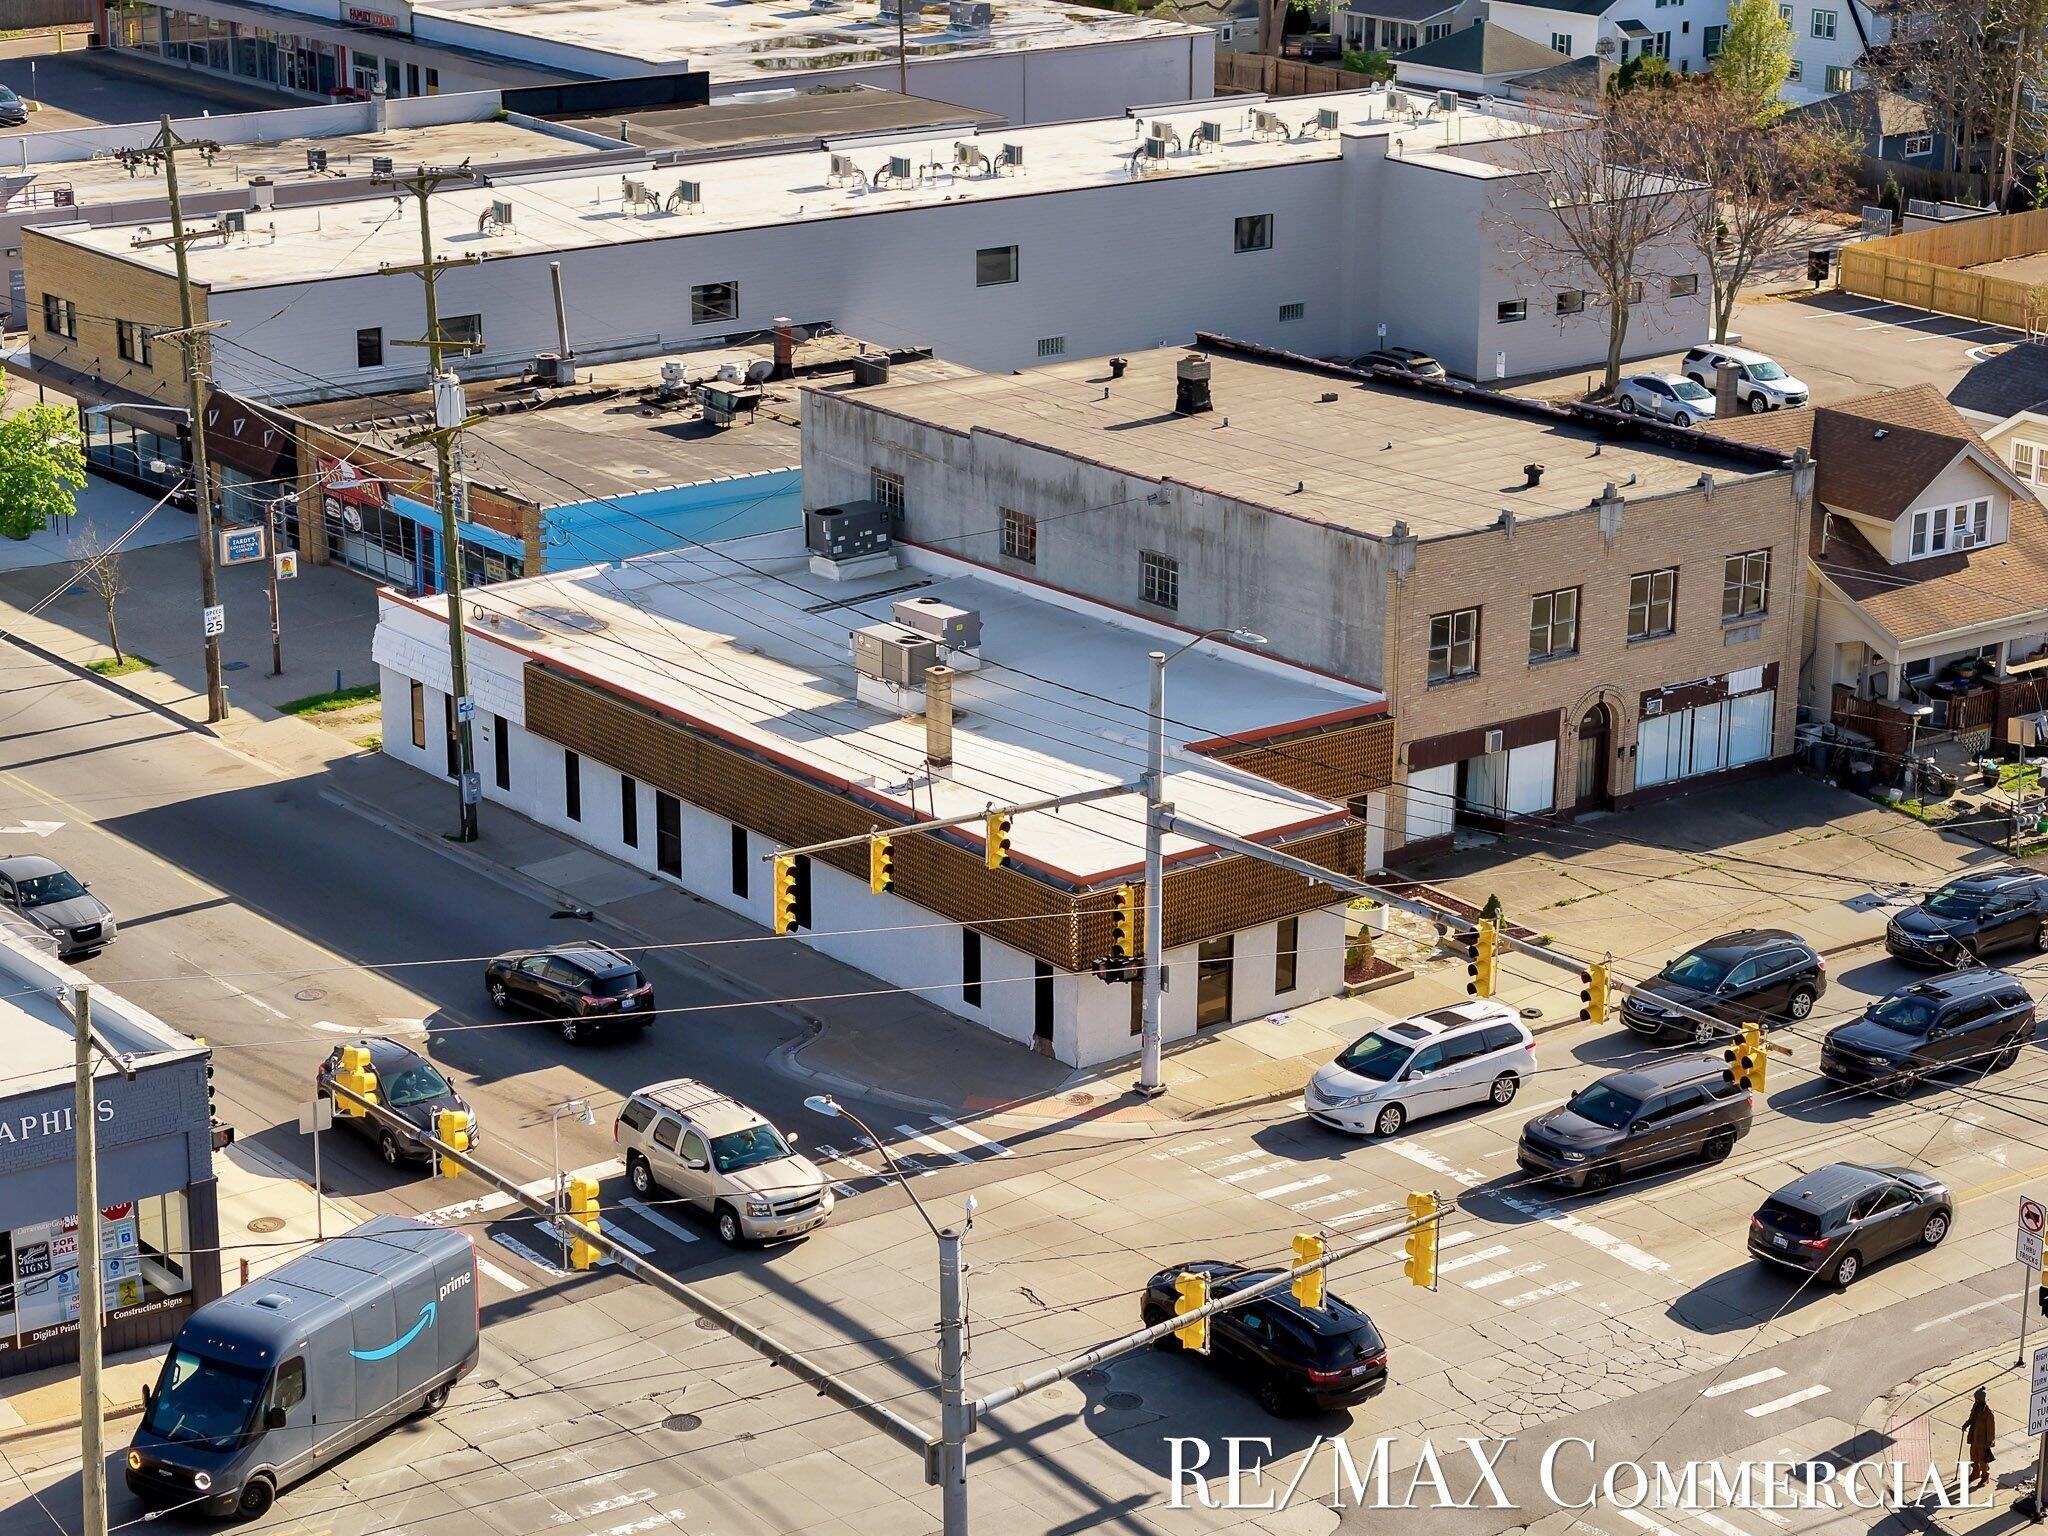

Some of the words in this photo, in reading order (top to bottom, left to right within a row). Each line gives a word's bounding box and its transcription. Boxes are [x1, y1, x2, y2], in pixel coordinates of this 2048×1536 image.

[232, 536, 256, 545] TARDY'S
[206, 608, 222, 616] SPEED
[207, 614, 221, 622] LIMIT
[207, 620, 222, 633] 25
[0, 1099, 115, 1145] APHIS
[52, 1237, 75, 1248] FOR
[2026, 1237, 2034, 1246] NO
[52, 1244, 78, 1256] SALE
[2023, 1243, 2037, 1256] THRU
[2019, 1250, 2039, 1266] TRUCKS
[19, 1260, 49, 1275] SIGNS
[439, 1271, 471, 1302] prime
[113, 1302, 162, 1319] Construction
[162, 1297, 183, 1308] Signs
[32, 1327, 58, 1341] Digital
[60, 1321, 80, 1334] Printi
[2031, 1420, 2042, 1431] ON
